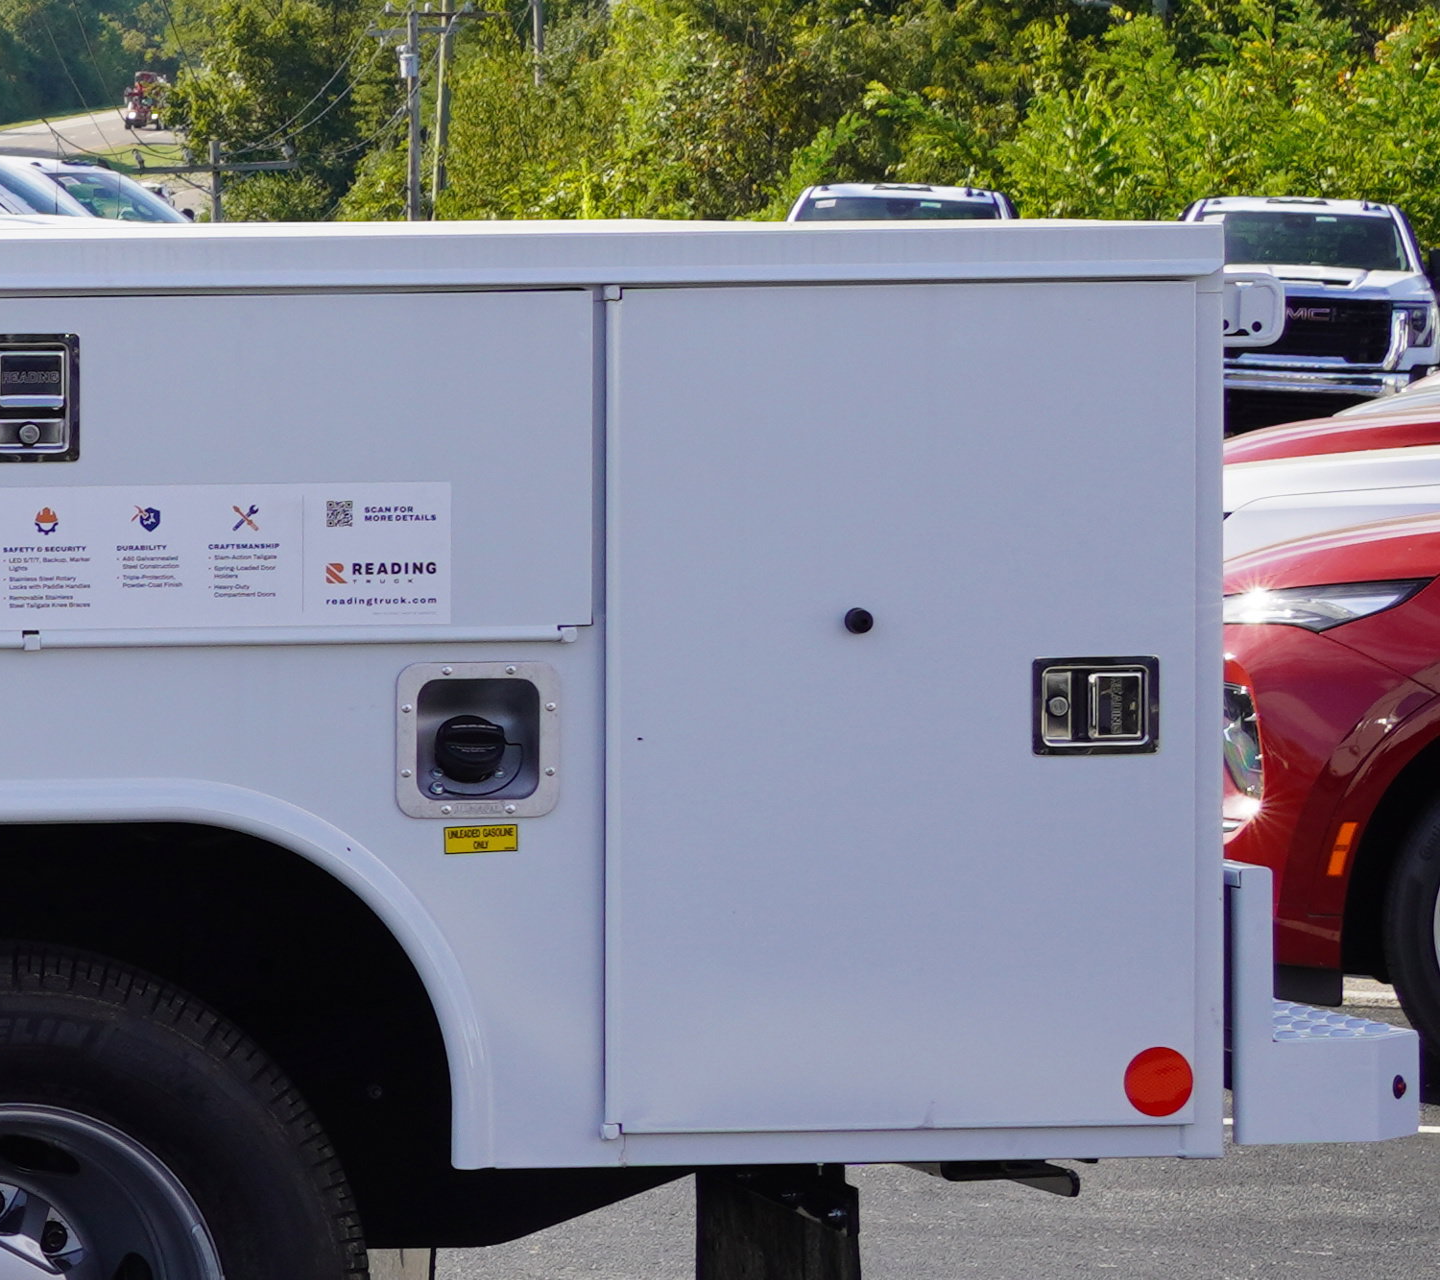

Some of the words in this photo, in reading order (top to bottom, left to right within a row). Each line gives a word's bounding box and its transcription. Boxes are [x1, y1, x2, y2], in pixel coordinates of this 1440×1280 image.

[1286, 307, 1331, 321] MC
[364, 506, 392, 514] SCAN
[364, 514, 393, 522] MORE
[351, 562, 437, 575] READING
[326, 596, 437, 606] readingtruck.com
[447, 828, 481, 839] UNLEADED
[482, 827, 514, 838] GASOLINE
[473, 840, 489, 850] ONLY
